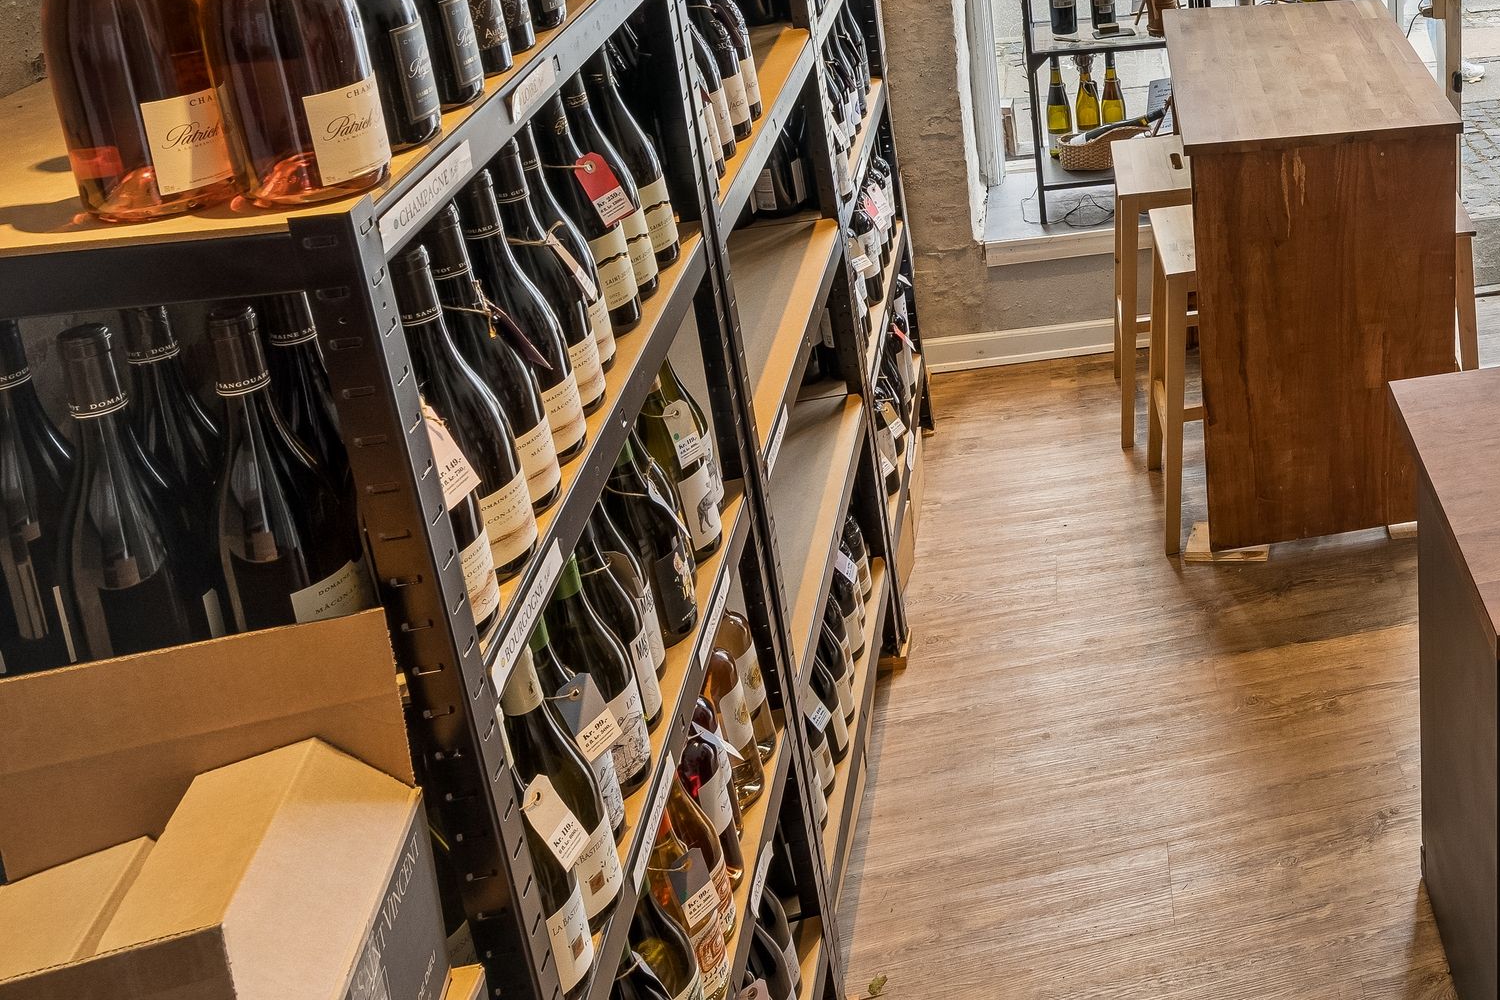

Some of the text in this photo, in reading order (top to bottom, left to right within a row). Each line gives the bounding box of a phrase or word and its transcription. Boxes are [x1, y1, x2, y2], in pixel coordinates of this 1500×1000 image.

[399, 169, 450, 227] CHAMPAGNE
[217, 369, 271, 390] SANGOUAR
[446, 457, 462, 472] 149,-
[504, 583, 546, 663] BOURGOGNE
[582, 717, 608, 741] kr. 99,-
[553, 821, 575, 848] kr. 119,-
[381, 831, 420, 931] VINCENT
[687, 899, 698, 909] kr.
[552, 923, 564, 937] LA
